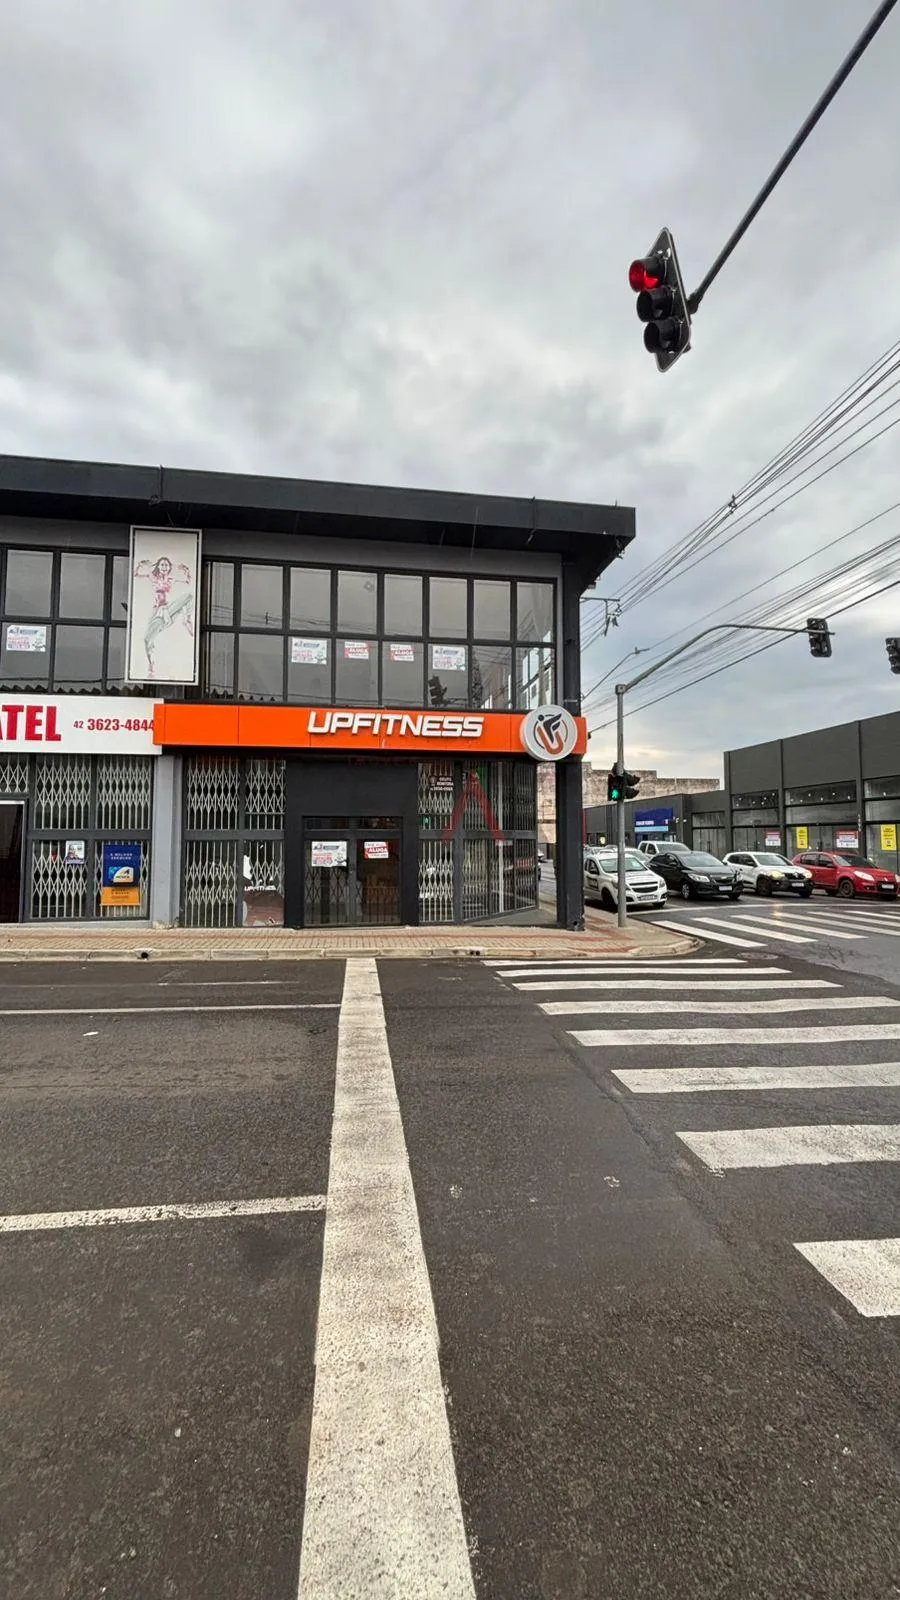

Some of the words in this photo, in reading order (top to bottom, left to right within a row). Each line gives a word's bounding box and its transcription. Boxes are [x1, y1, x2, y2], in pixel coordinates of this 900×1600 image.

[0, 704, 62, 742] TEL
[73, 720, 84, 729] 42
[87, 718, 154, 732] 3623-4844
[307, 711, 485, 738] UPFITNESS
